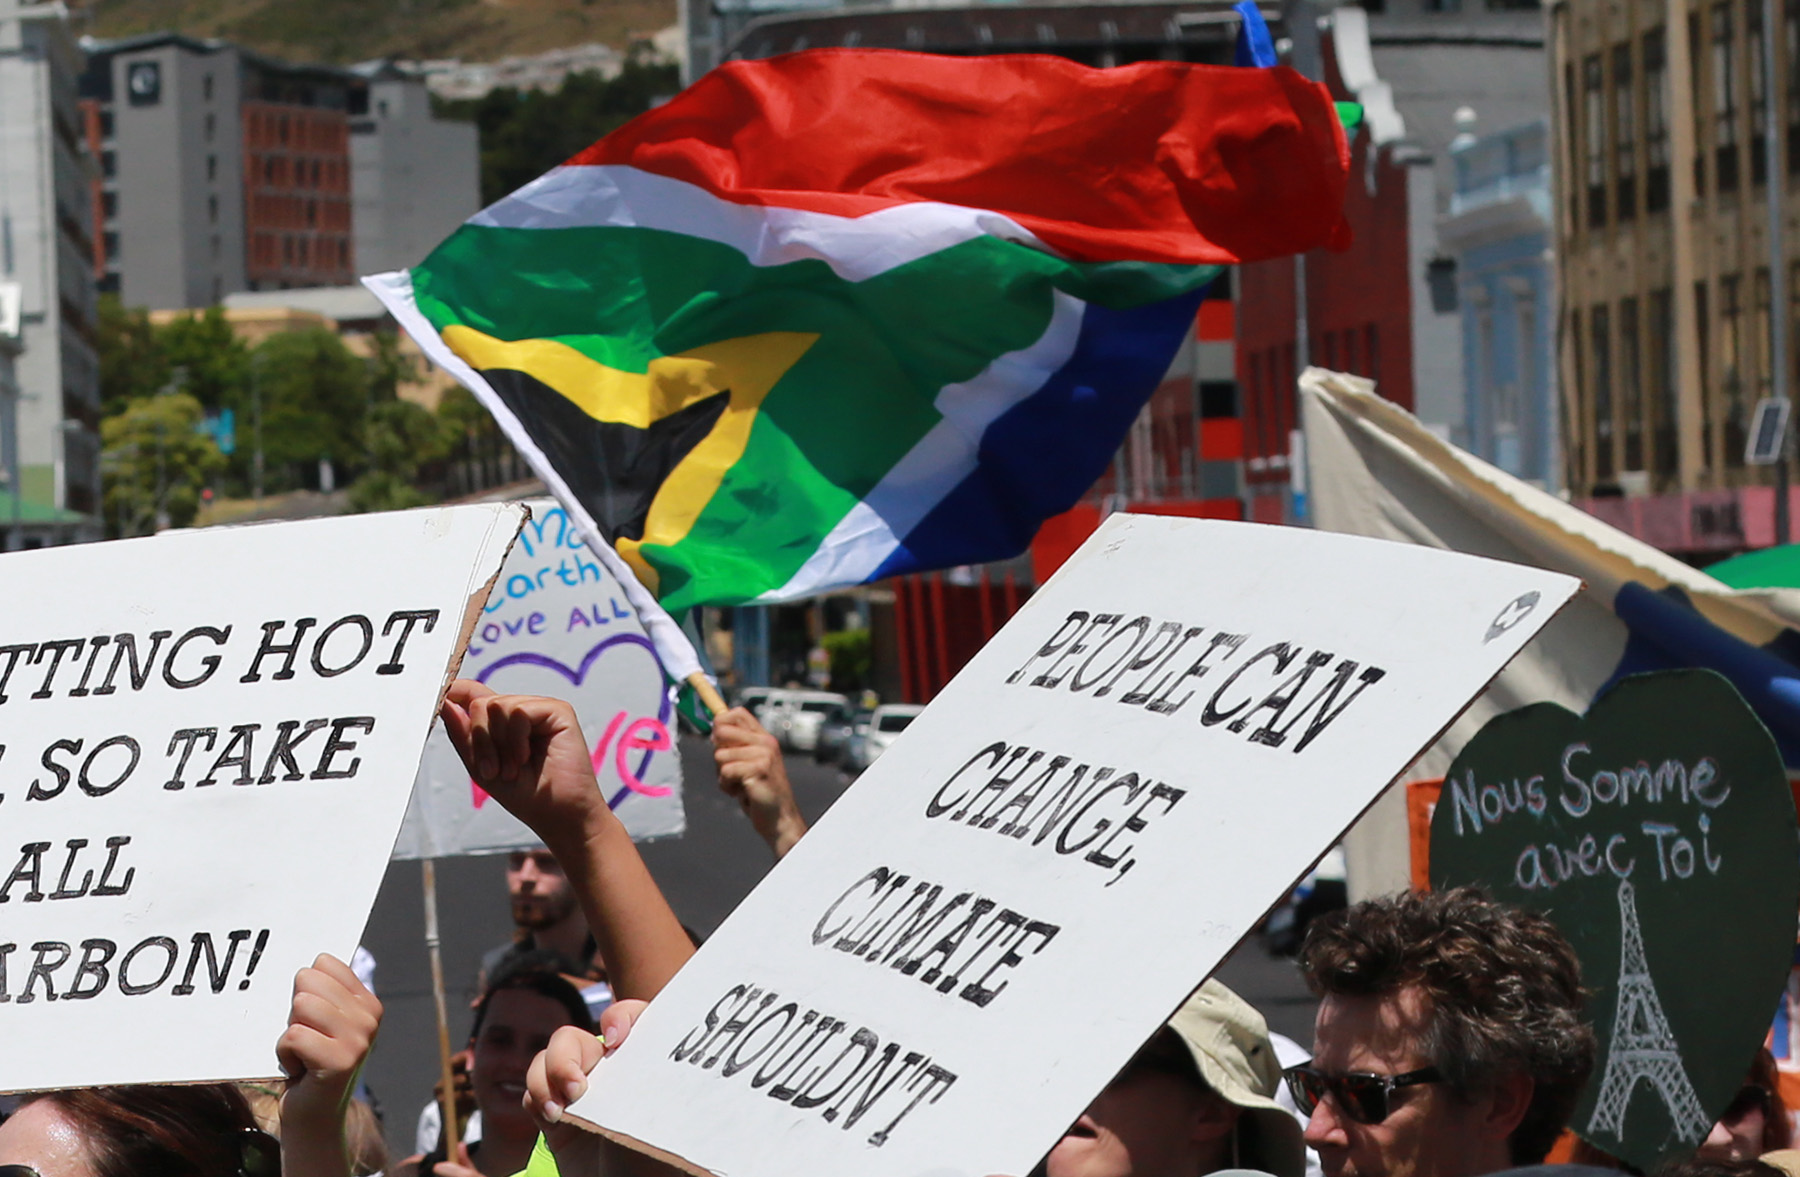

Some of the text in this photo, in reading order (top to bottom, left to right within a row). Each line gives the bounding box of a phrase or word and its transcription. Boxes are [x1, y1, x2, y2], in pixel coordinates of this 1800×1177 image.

[239, 609, 439, 684] HOT
[566, 598, 630, 632] ALL
[1005, 611, 1387, 754] PEOPLE CAN
[27, 734, 141, 802] SO
[164, 716, 375, 791] TAKE
[1450, 743, 1731, 836] Nous Somme
[926, 741, 1188, 888] CHANGE,
[1514, 813, 1721, 889] avec Toi
[812, 866, 1061, 1008] CLIMATE
